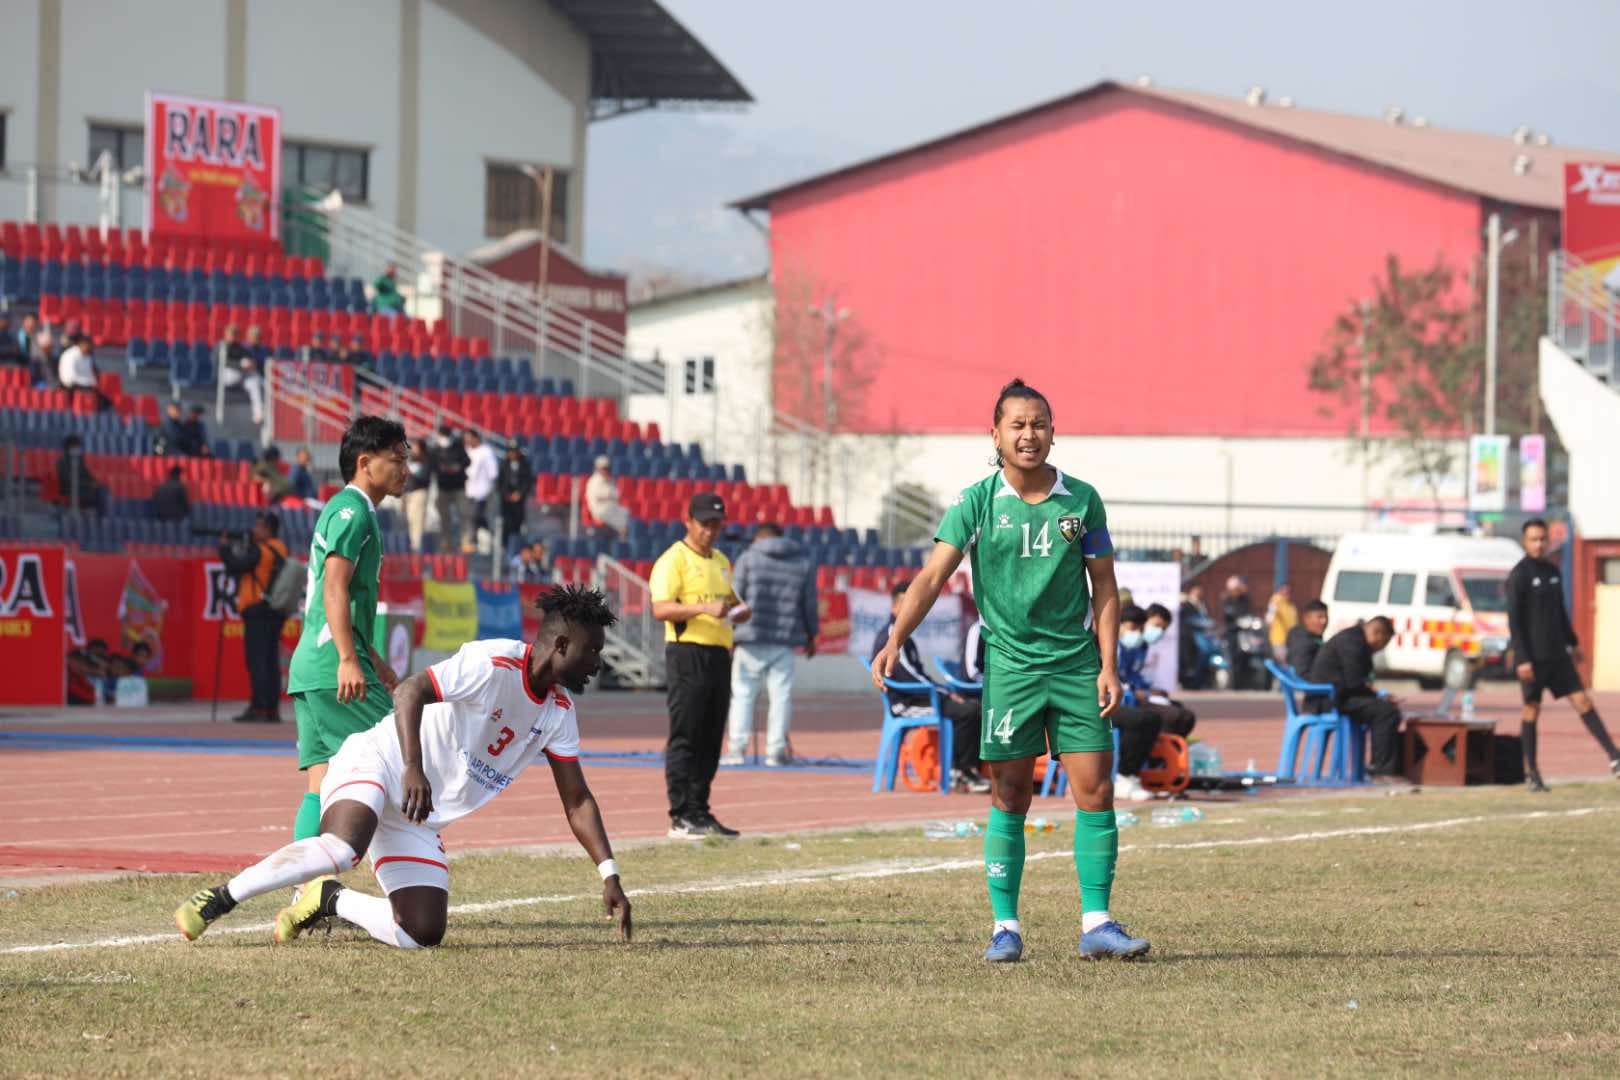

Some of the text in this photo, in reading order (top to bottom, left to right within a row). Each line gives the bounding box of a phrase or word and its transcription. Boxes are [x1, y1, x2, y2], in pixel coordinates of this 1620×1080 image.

[165, 108, 264, 168] RARA
[1020, 520, 1053, 558] 14
[487, 726, 515, 757] 3
[985, 708, 1016, 744] 14
